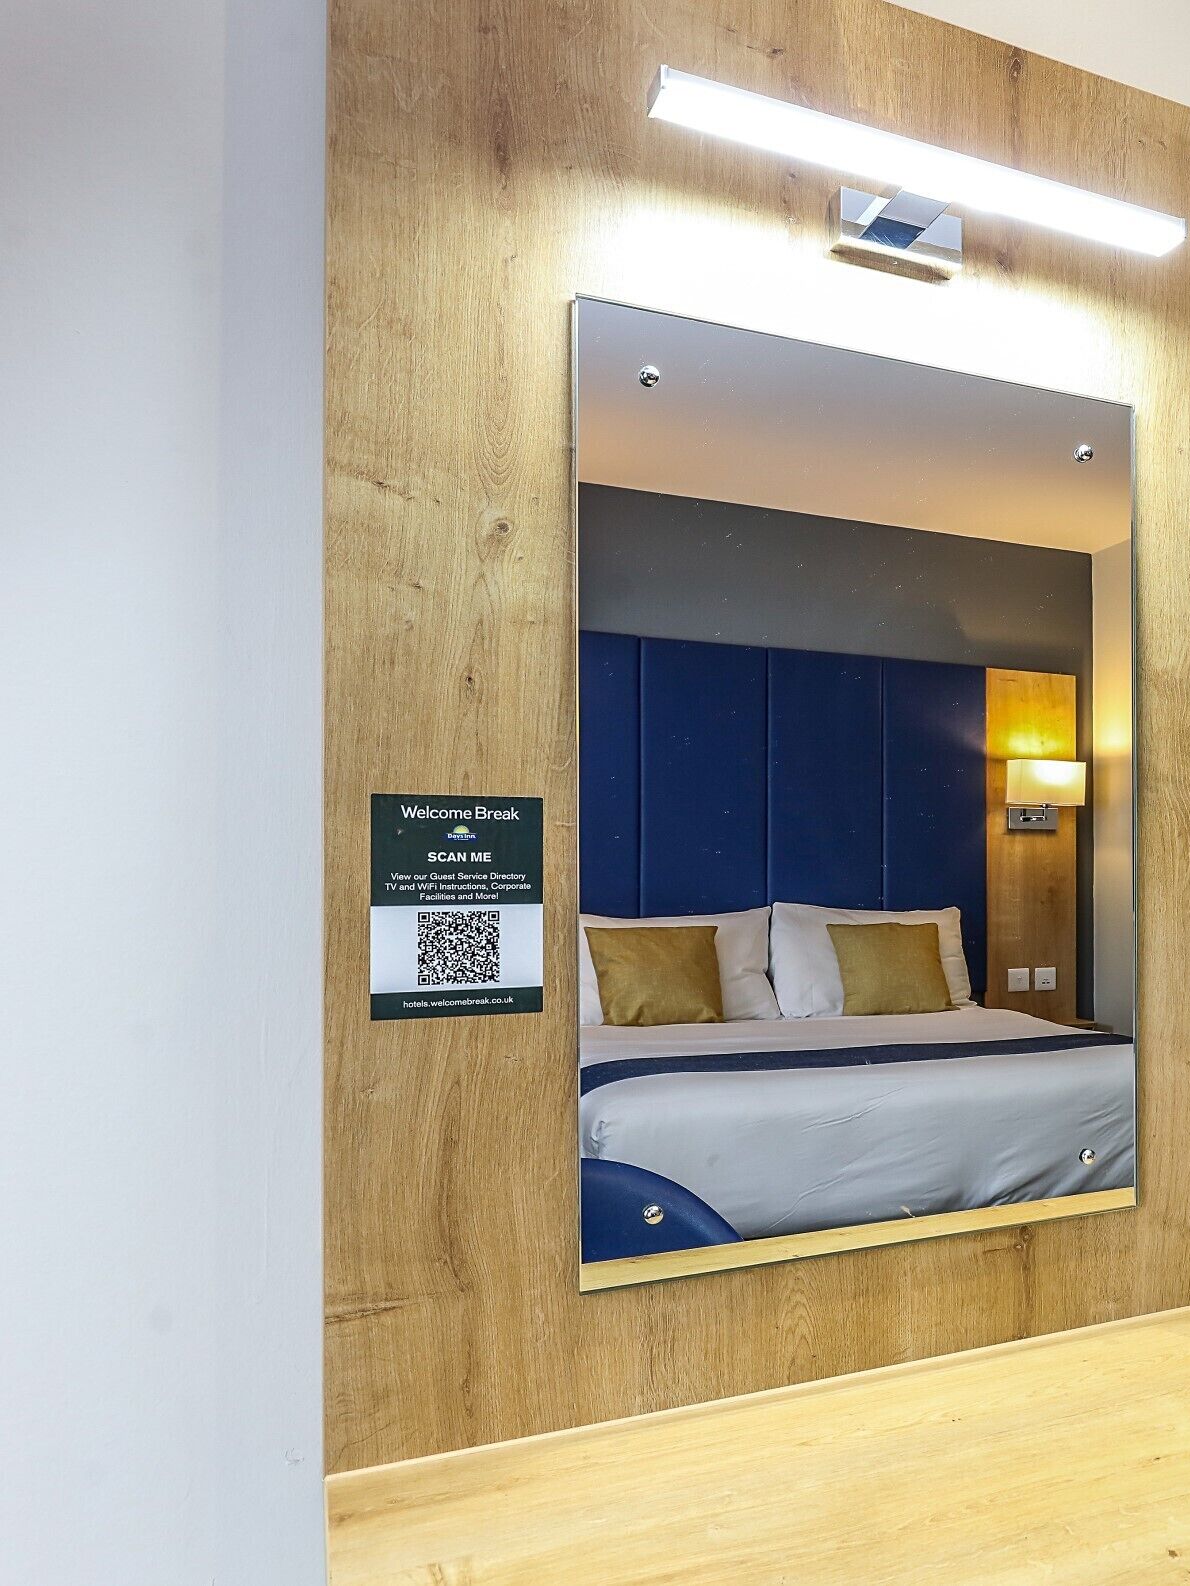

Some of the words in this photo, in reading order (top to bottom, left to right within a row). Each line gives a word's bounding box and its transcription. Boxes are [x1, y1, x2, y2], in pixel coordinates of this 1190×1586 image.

[400, 804, 472, 819] Welcome
[474, 806, 520, 820] Break
[427, 851, 467, 862] SCAN
[470, 852, 492, 862] ME
[390, 872, 412, 880] View
[429, 872, 456, 880] Guest
[457, 872, 488, 880] Service
[489, 872, 527, 881] Directory
[384, 882, 397, 890] TV
[399, 882, 415, 890] and
[417, 882, 438, 890] WiFi
[439, 882, 489, 891] Instructions,
[490, 882, 532, 892] Corporate
[419, 892, 456, 900] Facilities
[457, 892, 473, 900] and
[475, 892, 499, 900] More!
[403, 996, 514, 1008] hotels.welcomebreak.co.uk
